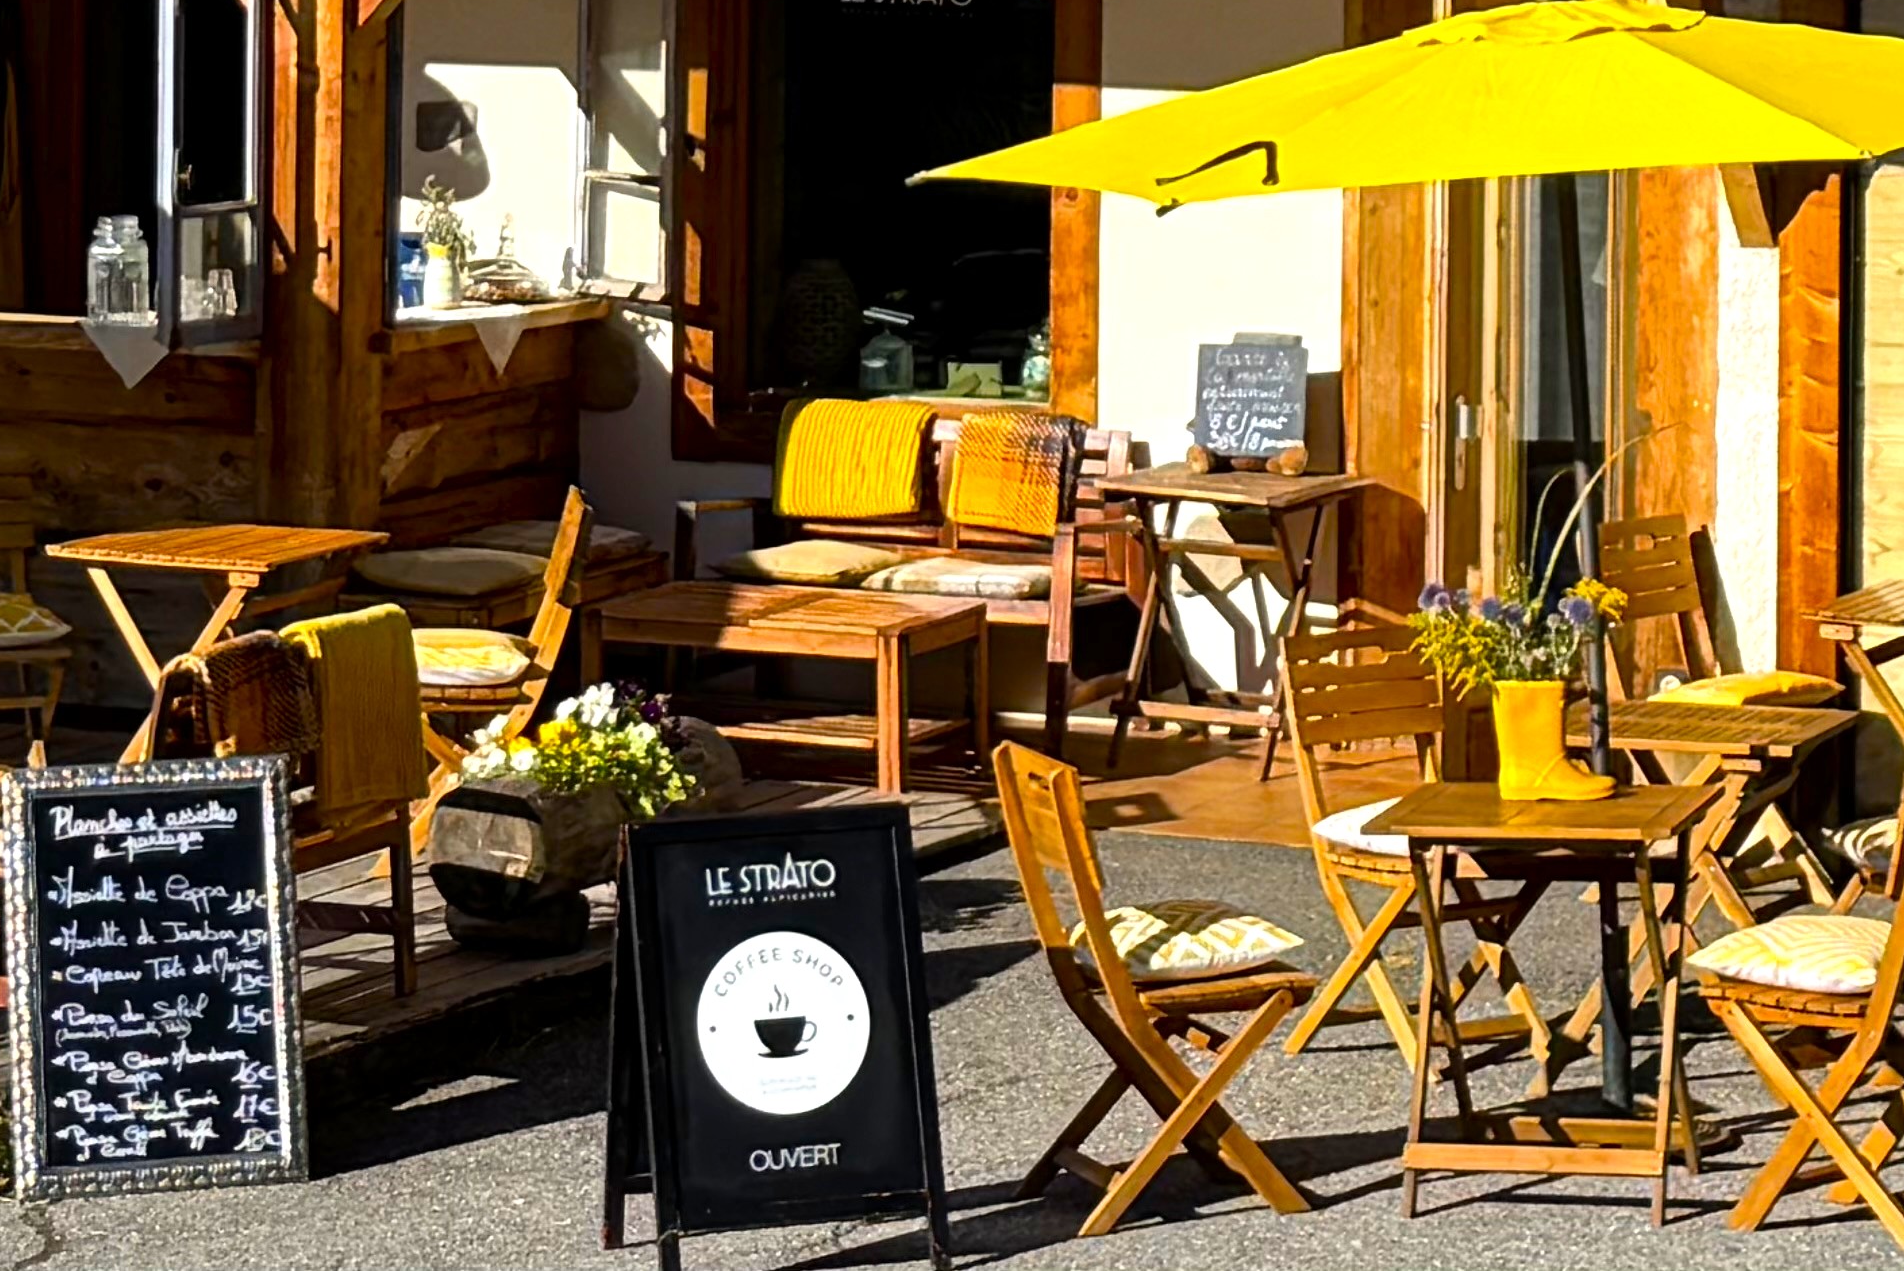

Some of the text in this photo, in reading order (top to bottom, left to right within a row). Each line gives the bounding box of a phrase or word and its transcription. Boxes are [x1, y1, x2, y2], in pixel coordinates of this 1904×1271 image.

[705, 851, 837, 896] LE STRATO
[134, 875, 158, 903] de
[137, 918, 157, 945] de
[192, 954, 212, 976] de
[714, 947, 844, 997] COFFEE SHOP
[749, 1143, 842, 1173] OUVERT
